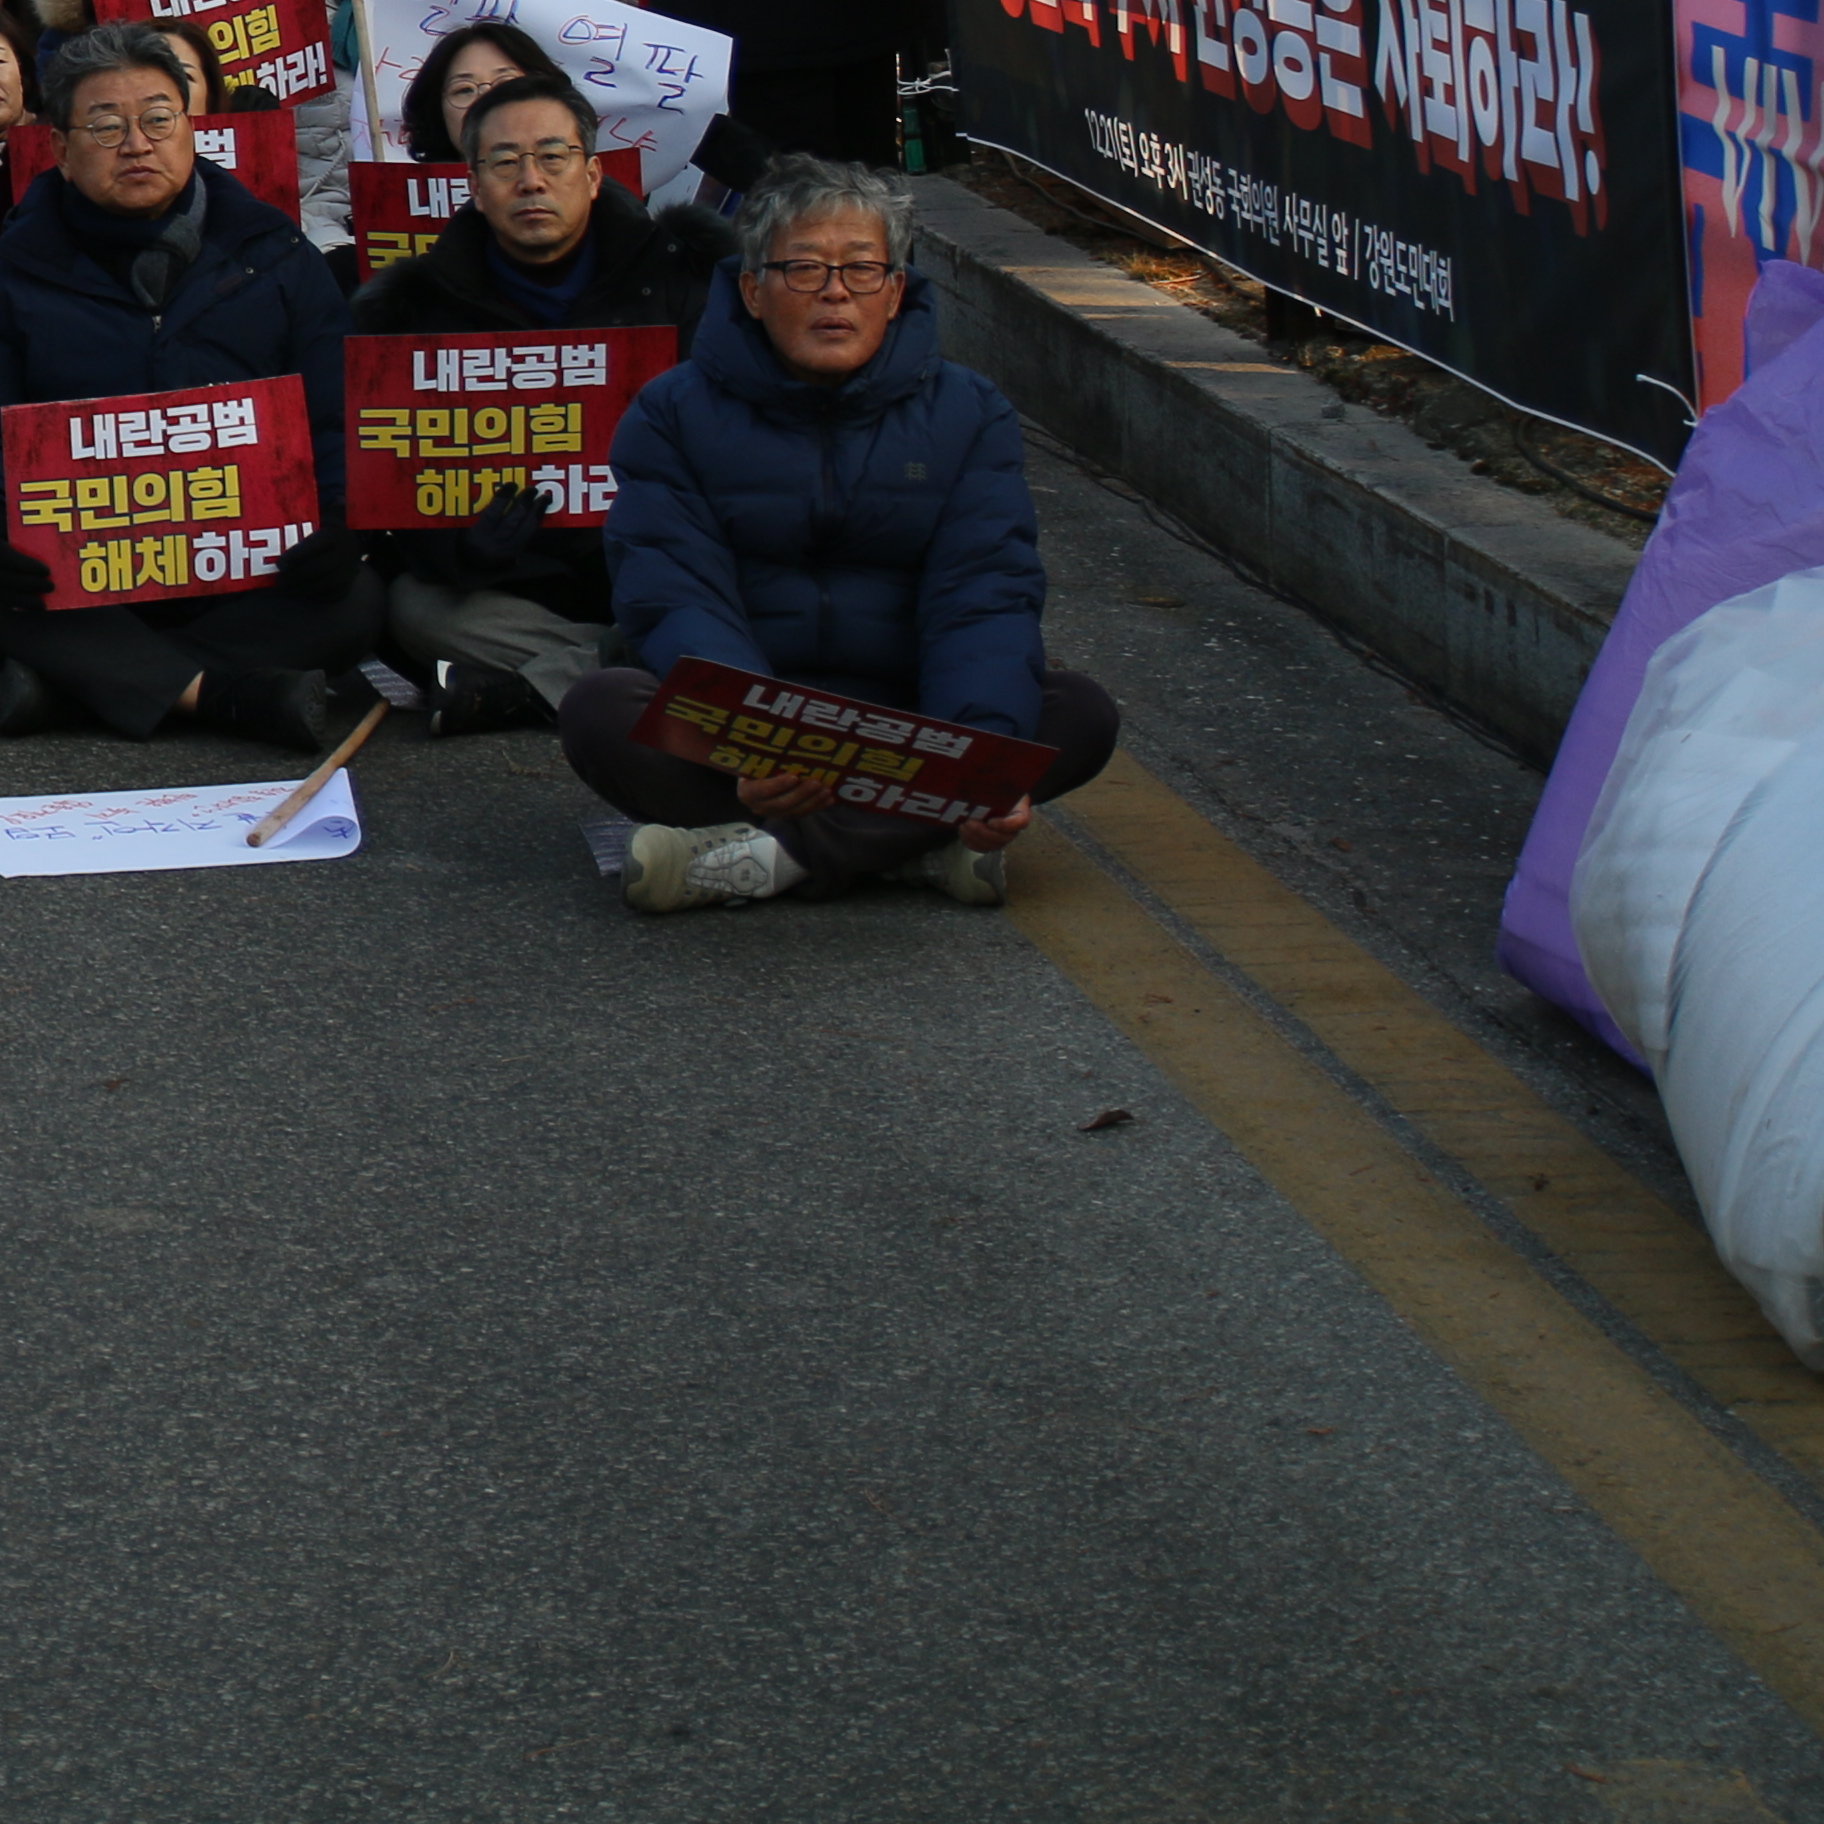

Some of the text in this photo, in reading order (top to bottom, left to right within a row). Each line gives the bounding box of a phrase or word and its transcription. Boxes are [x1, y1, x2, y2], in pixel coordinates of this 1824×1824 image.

[1139, 133, 1165, 188] 오후
[1165, 143, 1186, 200] 3시
[1187, 151, 1225, 219] 권성동
[1227, 168, 1281, 248] 국회의원
[1283, 193, 1329, 267] 사무실
[1331, 212, 1348, 276] 앞
[1363, 225, 1454, 323] 강원도민대회
[412, 344, 607, 394] 내란공범
[71, 399, 258, 461] 내란공범
[359, 403, 582, 458] 국민의힘
[20, 466, 240, 532] 국민의힘
[665, 695, 925, 783] 국민의힘
[743, 685, 974, 761] 내란공범
